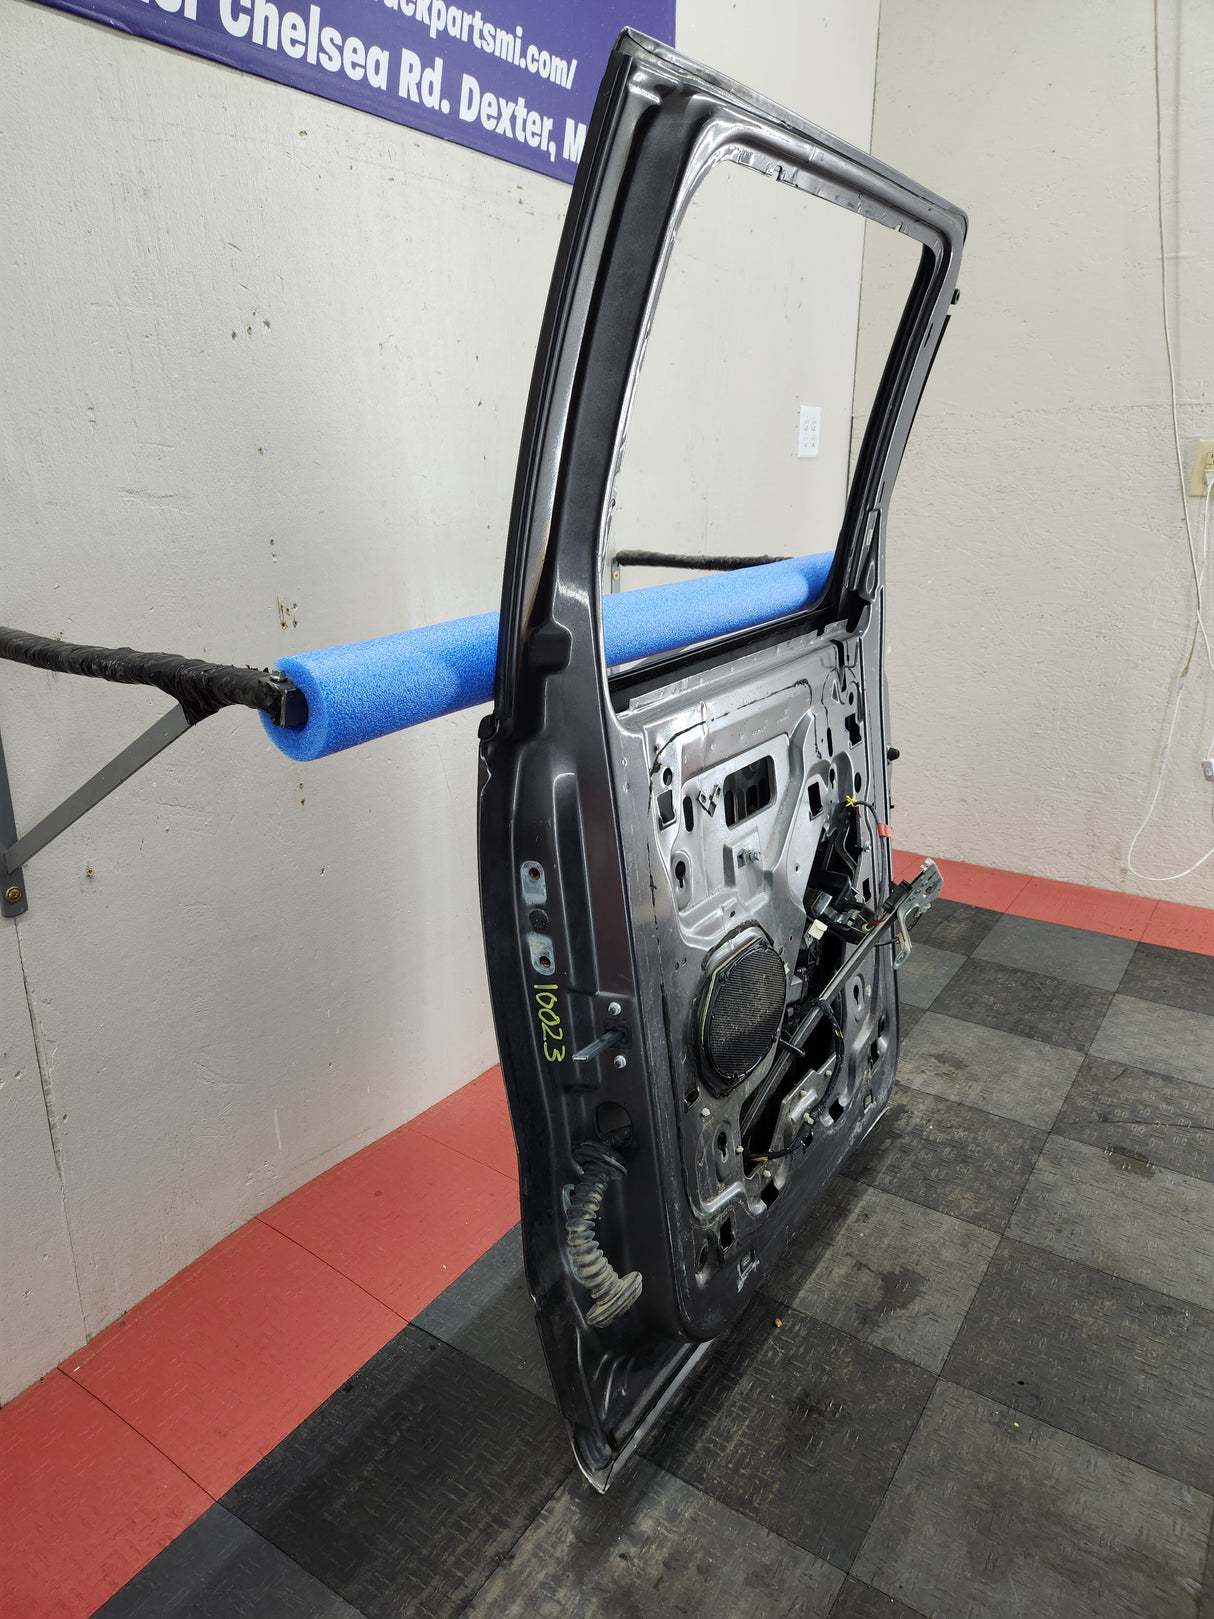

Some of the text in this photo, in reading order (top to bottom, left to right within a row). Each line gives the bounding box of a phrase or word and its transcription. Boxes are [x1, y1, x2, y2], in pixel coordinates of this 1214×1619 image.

[219, 0, 390, 91] Chelsea
[398, 47, 451, 115] Rd.
[459, 73, 557, 163] Dexter,
[533, 984, 566, 1062] 10023
